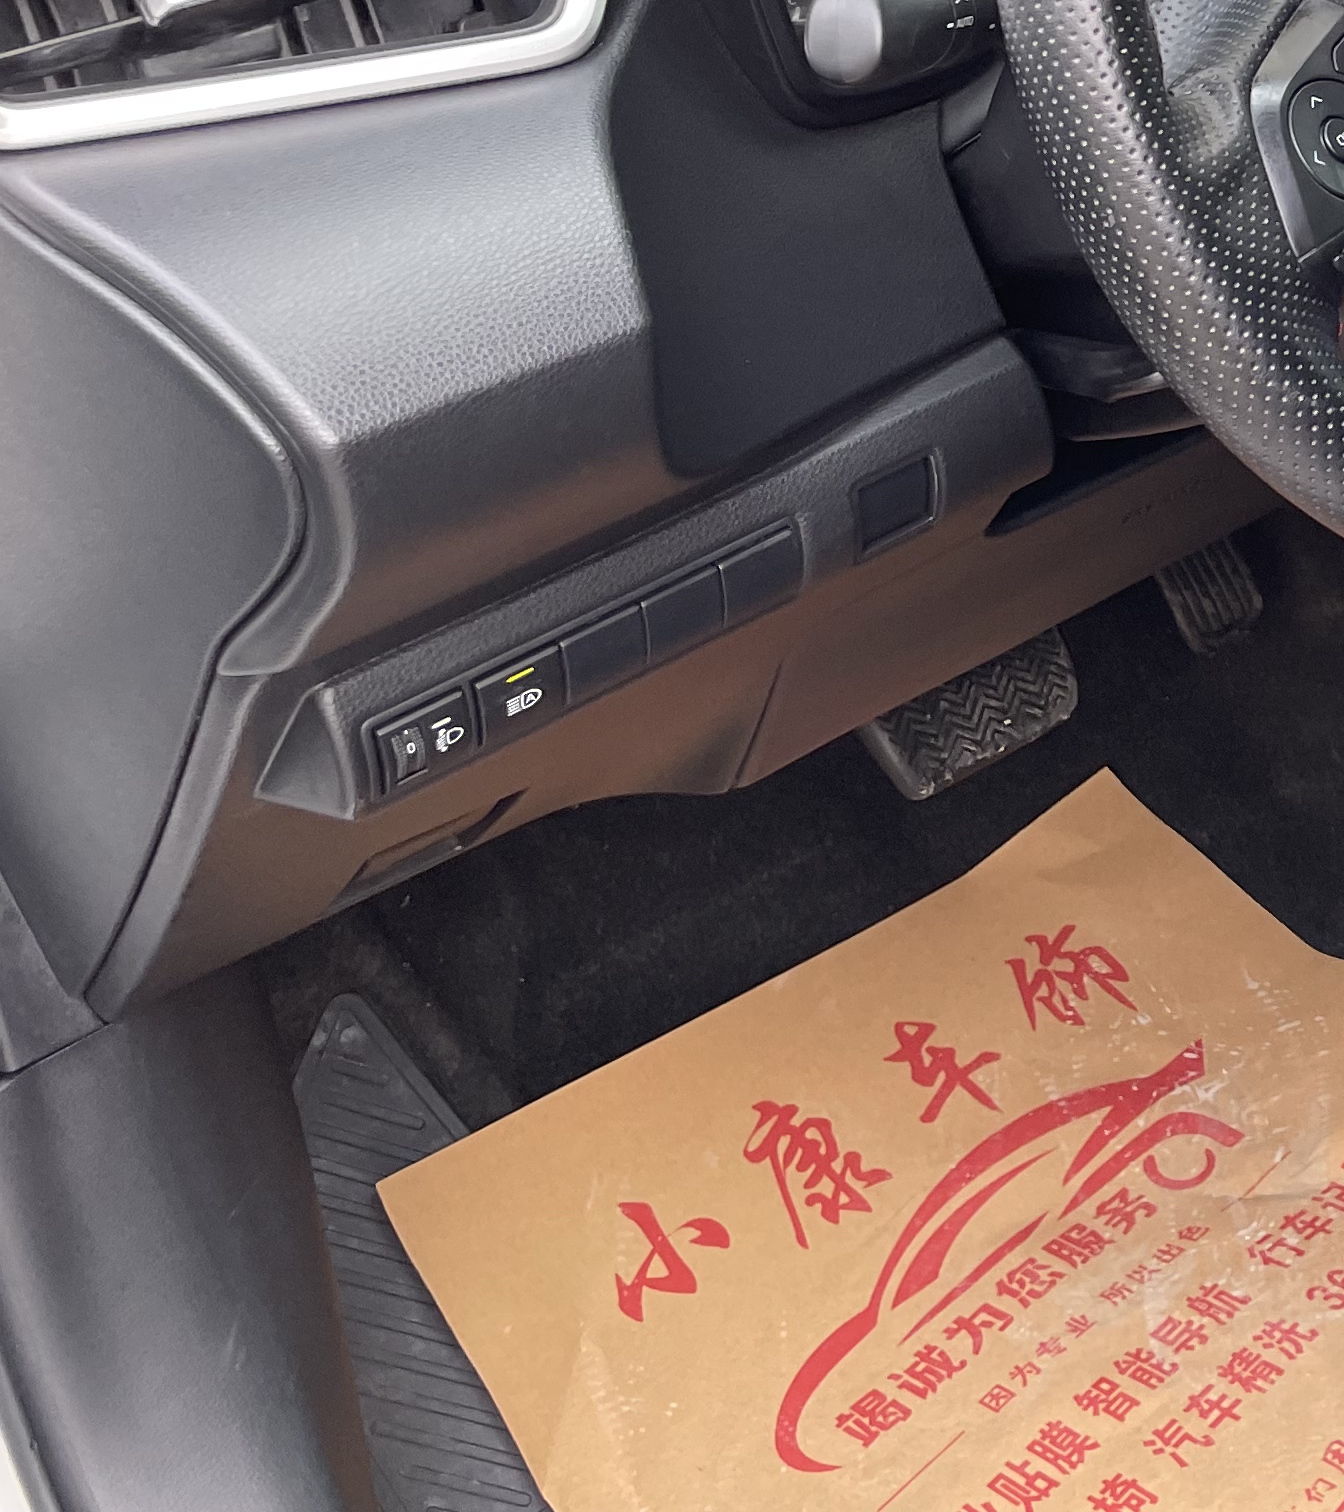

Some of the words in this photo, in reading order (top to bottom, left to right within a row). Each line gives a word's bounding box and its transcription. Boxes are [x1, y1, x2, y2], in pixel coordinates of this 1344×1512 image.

[615, 924, 1138, 1322] 小康车饰
[836, 1186, 1157, 1447] 竭诚为您服务
[957, 1420, 1101, 1512] 贴膜
[1073, 1283, 1251, 1423] 智能导航
[979, 1313, 1097, 1413] 因为专业
[1099, 1224, 1210, 1307] 所以出色
[1142, 1318, 1319, 1468] 汽车精洗
